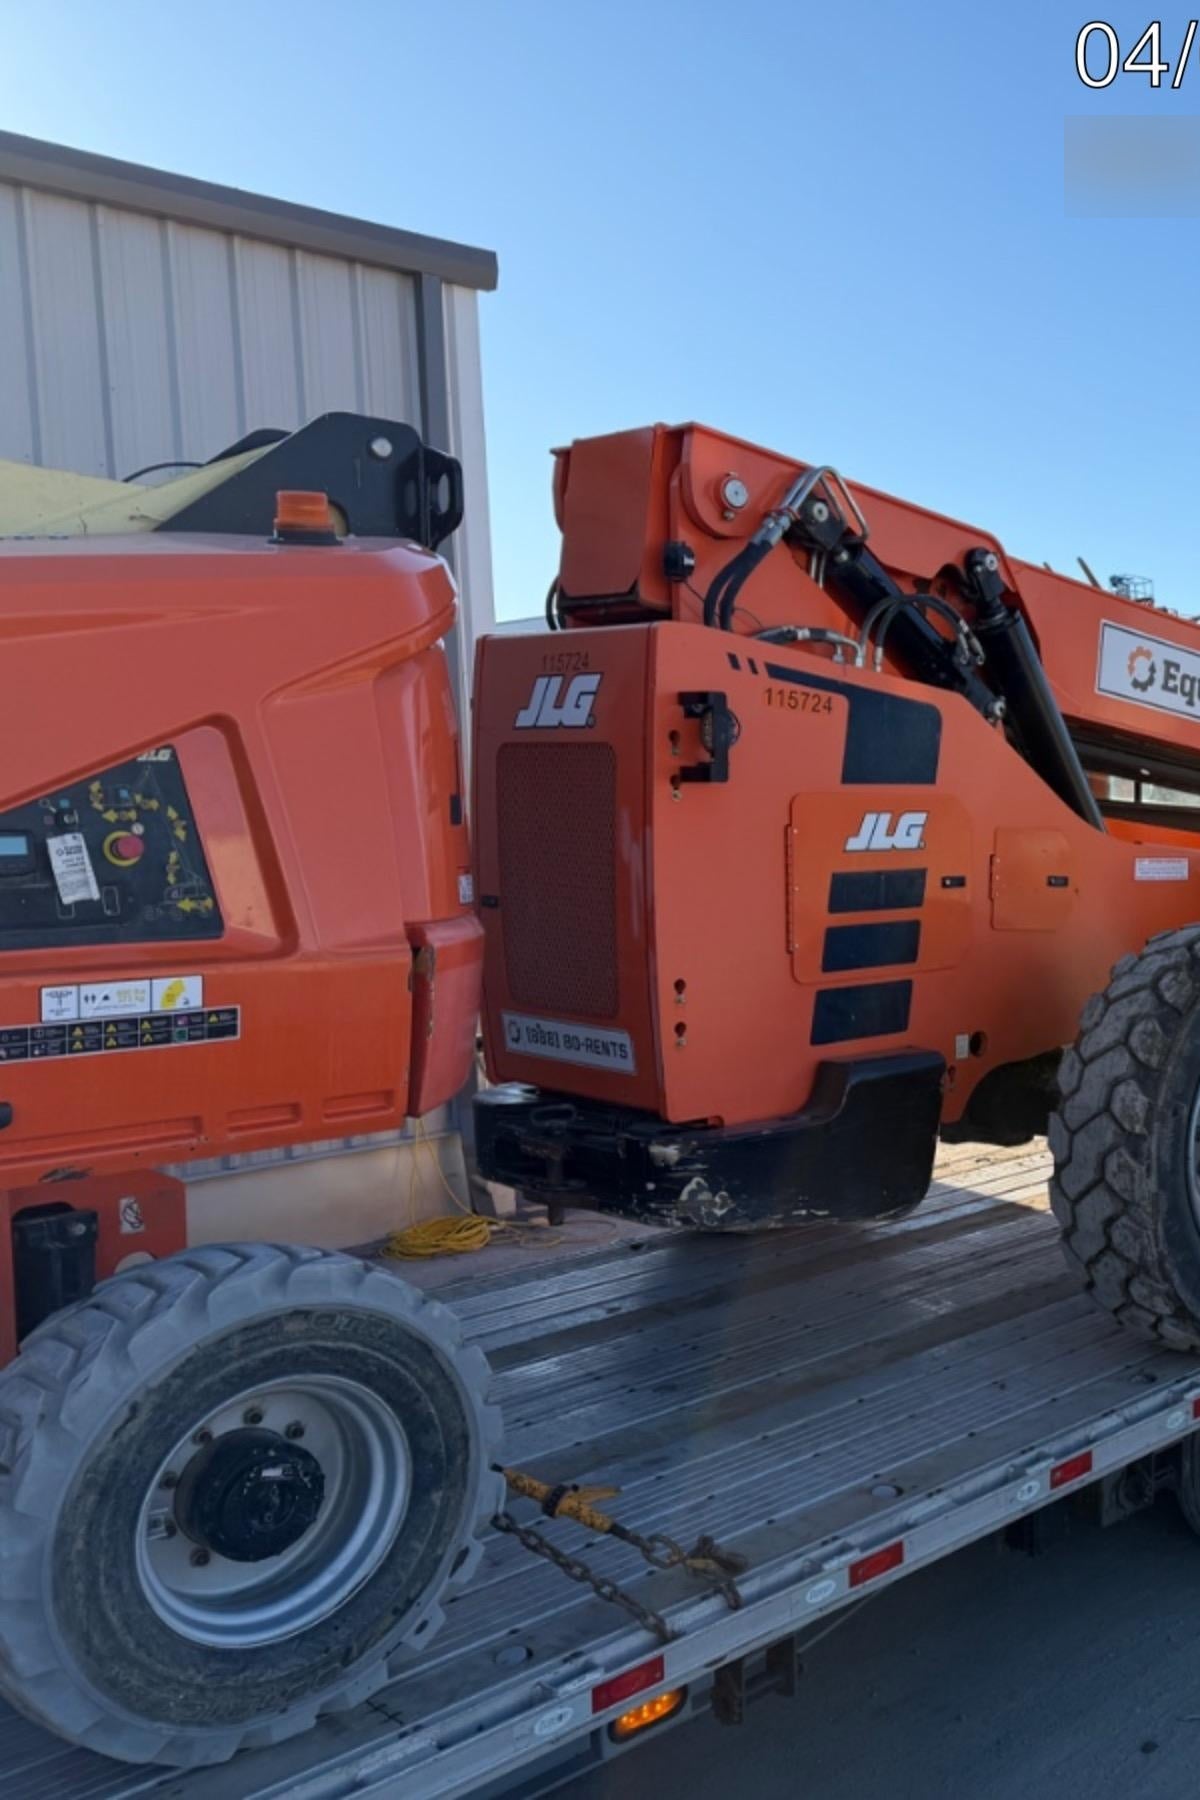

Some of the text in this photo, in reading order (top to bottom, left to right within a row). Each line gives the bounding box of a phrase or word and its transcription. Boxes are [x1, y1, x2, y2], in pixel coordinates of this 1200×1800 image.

[542, 651, 590, 671] 115724
[513, 672, 604, 730] JLG
[764, 687, 833, 715] 115724
[843, 810, 929, 852] JLG
